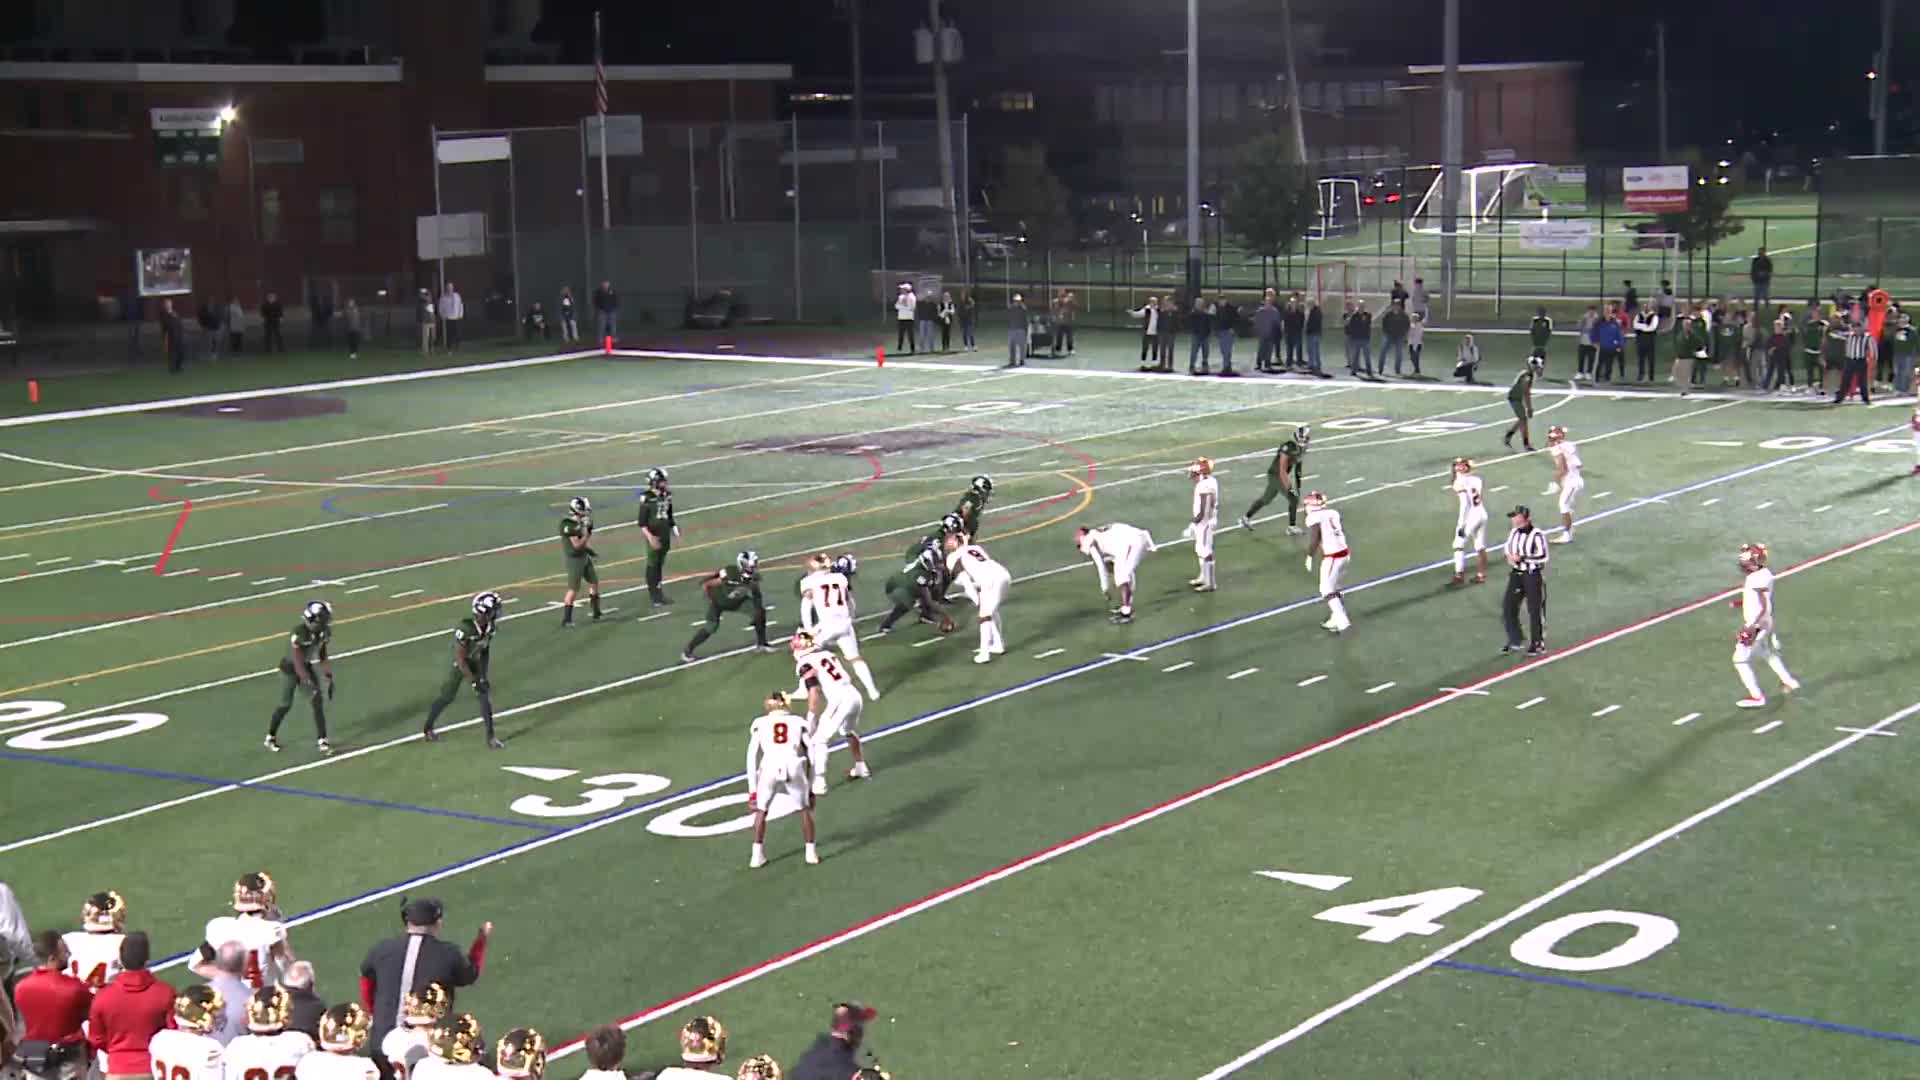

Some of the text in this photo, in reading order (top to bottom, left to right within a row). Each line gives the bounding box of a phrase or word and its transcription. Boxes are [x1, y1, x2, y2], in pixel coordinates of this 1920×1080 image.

[820, 583, 845, 608] 77
[773, 722, 788, 744] 8
[1312, 886, 1680, 971] 40
